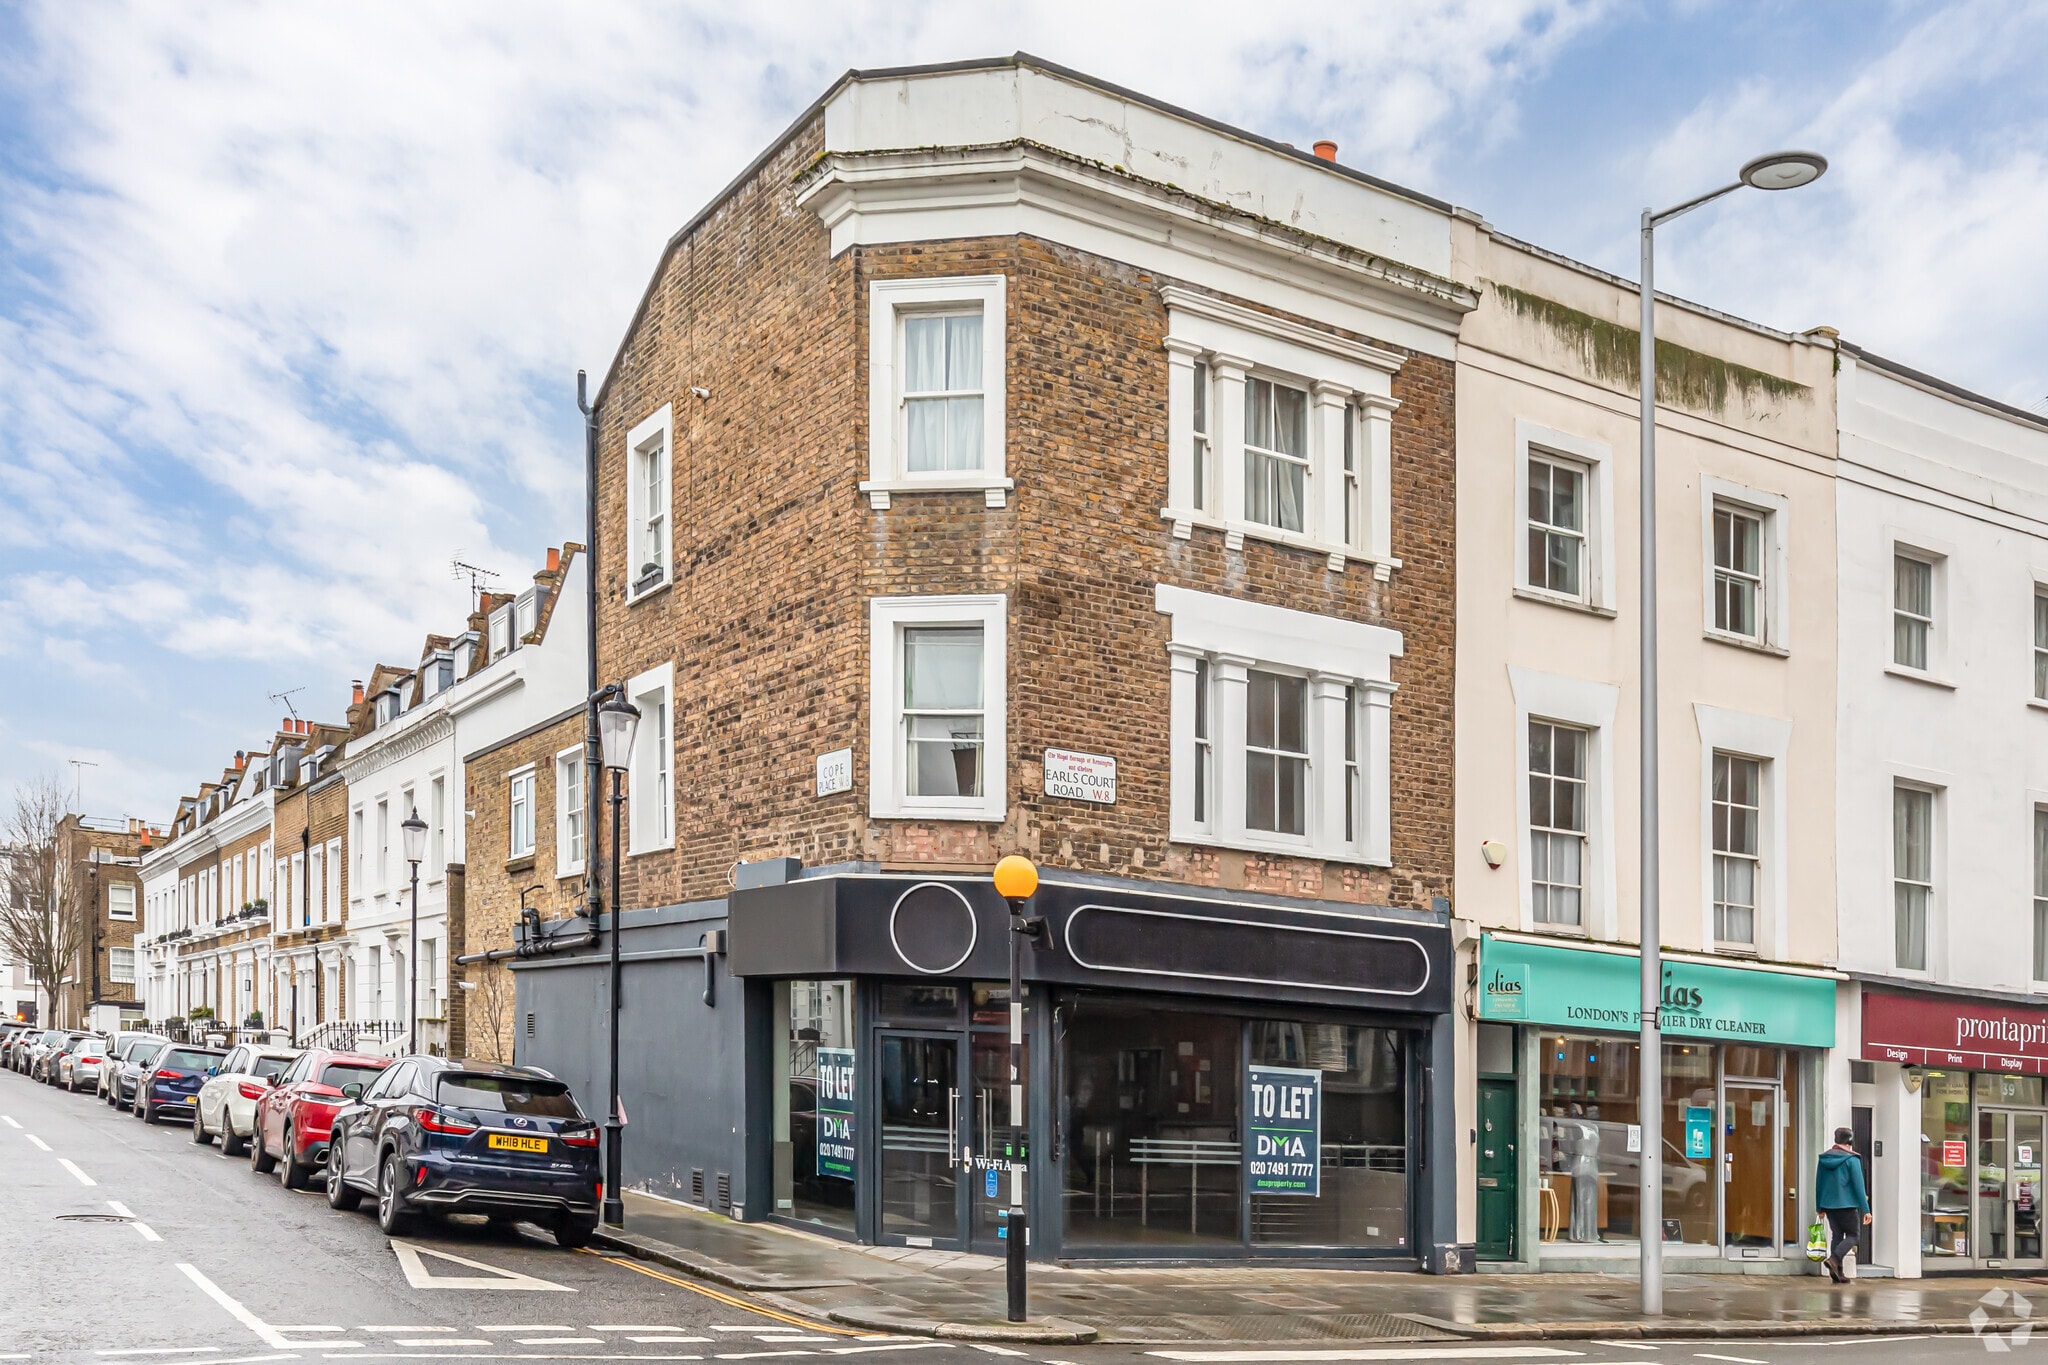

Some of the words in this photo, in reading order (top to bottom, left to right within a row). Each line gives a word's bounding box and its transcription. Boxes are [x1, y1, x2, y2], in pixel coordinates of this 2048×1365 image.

[823, 763, 844, 779] COPE
[1046, 769, 1079, 783] EARLS
[1081, 774, 1116, 789] COURT
[1053, 784, 1085, 798] ROAD.
[1487, 967, 1522, 992] elias
[1568, 1006, 1628, 1023] LONDON'S
[1690, 1017, 1712, 1030] DRY
[1715, 1020, 1766, 1035] CLEANER
[1956, 1016, 2048, 1051] prontapri
[1887, 1048, 1908, 1061] Design
[1947, 1054, 1963, 1064] Print
[2001, 1057, 2023, 1070] Display
[820, 1064, 833, 1099] TO
[835, 1066, 854, 1101] LET
[2002, 1083, 2015, 1096] 39
[1251, 1084, 1275, 1118] TO
[1280, 1086, 1313, 1120] LET
[823, 1116, 850, 1140] DMA
[496, 1136, 518, 1148] WH18
[521, 1138, 541, 1150] HLE
[1257, 1135, 1306, 1157] DMA
[975, 1158, 1003, 1170] Wi-Fi
[1004, 1159, 1028, 1172] Aa
[1250, 1161, 1265, 1174] 020
[1266, 1162, 1288, 1176] 7491
[1291, 1163, 1313, 1177] 7777
